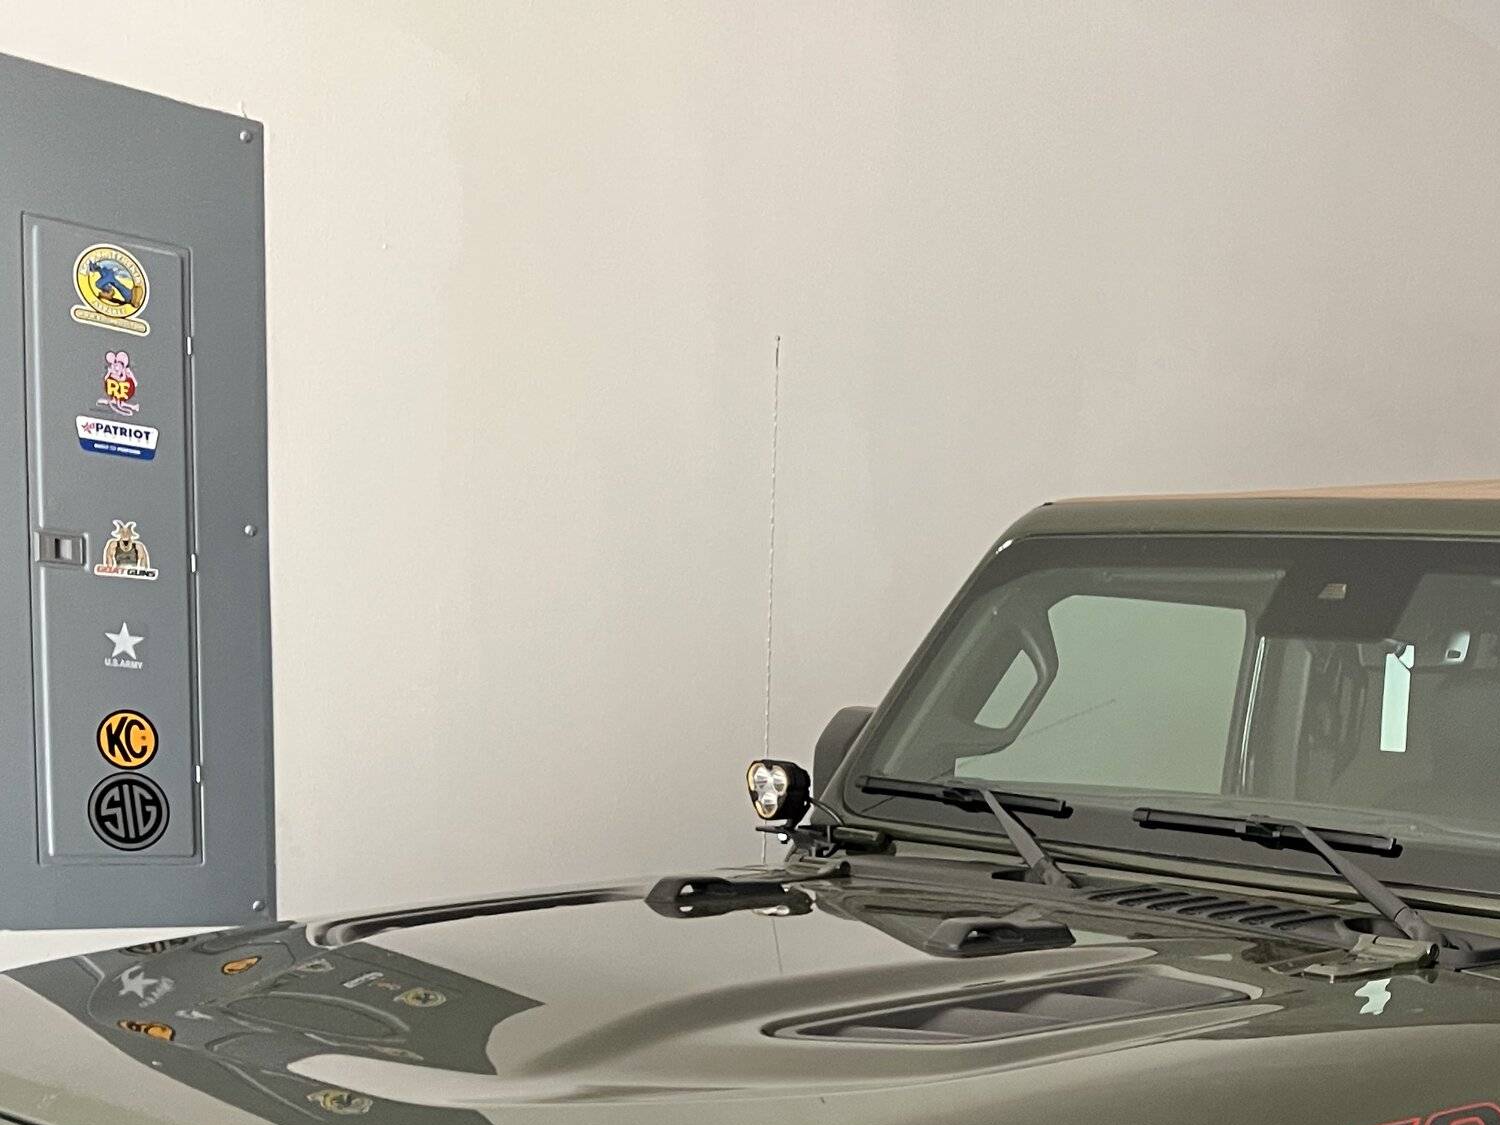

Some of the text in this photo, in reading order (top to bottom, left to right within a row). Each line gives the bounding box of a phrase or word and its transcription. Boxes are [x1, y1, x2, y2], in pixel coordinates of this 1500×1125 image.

[95, 423, 151, 441] PATRIOT
[119, 659, 144, 670] ARMY
[106, 716, 149, 763] KC
[100, 783, 158, 840] SIG
